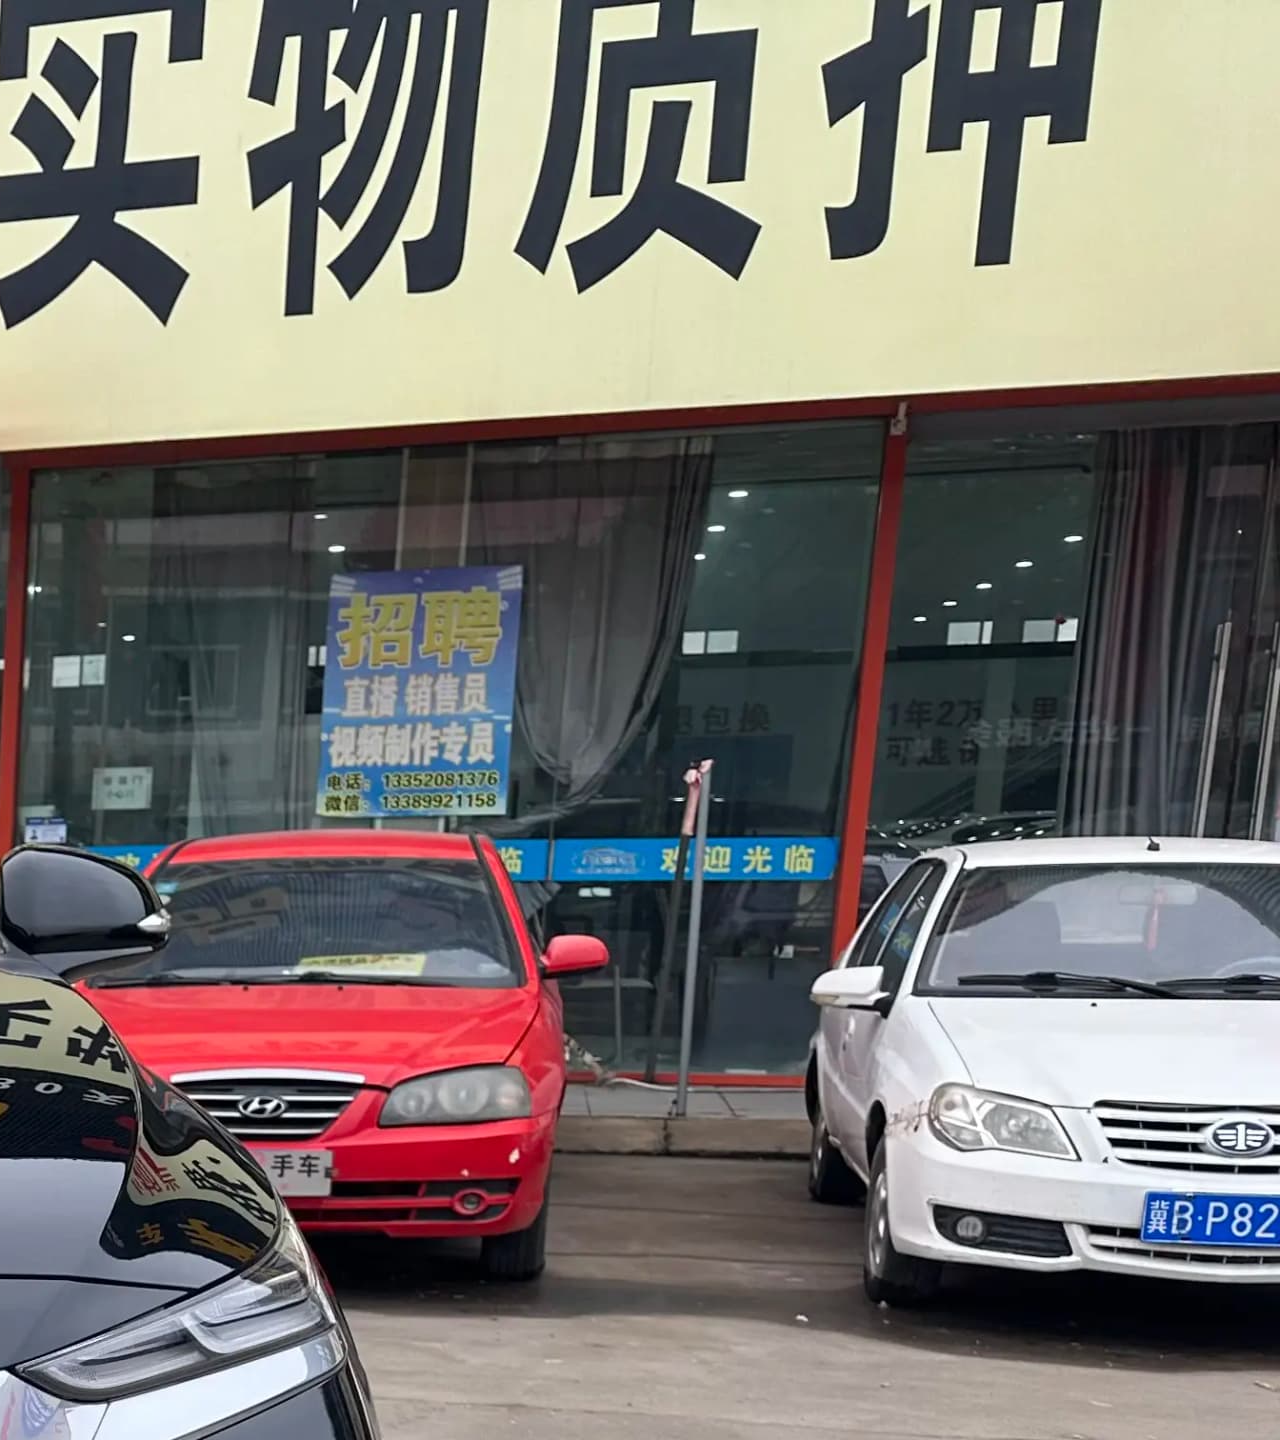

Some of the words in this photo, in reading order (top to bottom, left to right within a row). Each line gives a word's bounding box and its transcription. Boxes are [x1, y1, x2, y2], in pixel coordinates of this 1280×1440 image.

[337, 587, 503, 669] 招聘
[342, 675, 398, 718] 直播
[405, 672, 489, 716] 销售员
[329, 722, 495, 768] 视频制作专员
[661, 844, 816, 875] 欢迎光临
[271, 1154, 321, 1178] 手车
